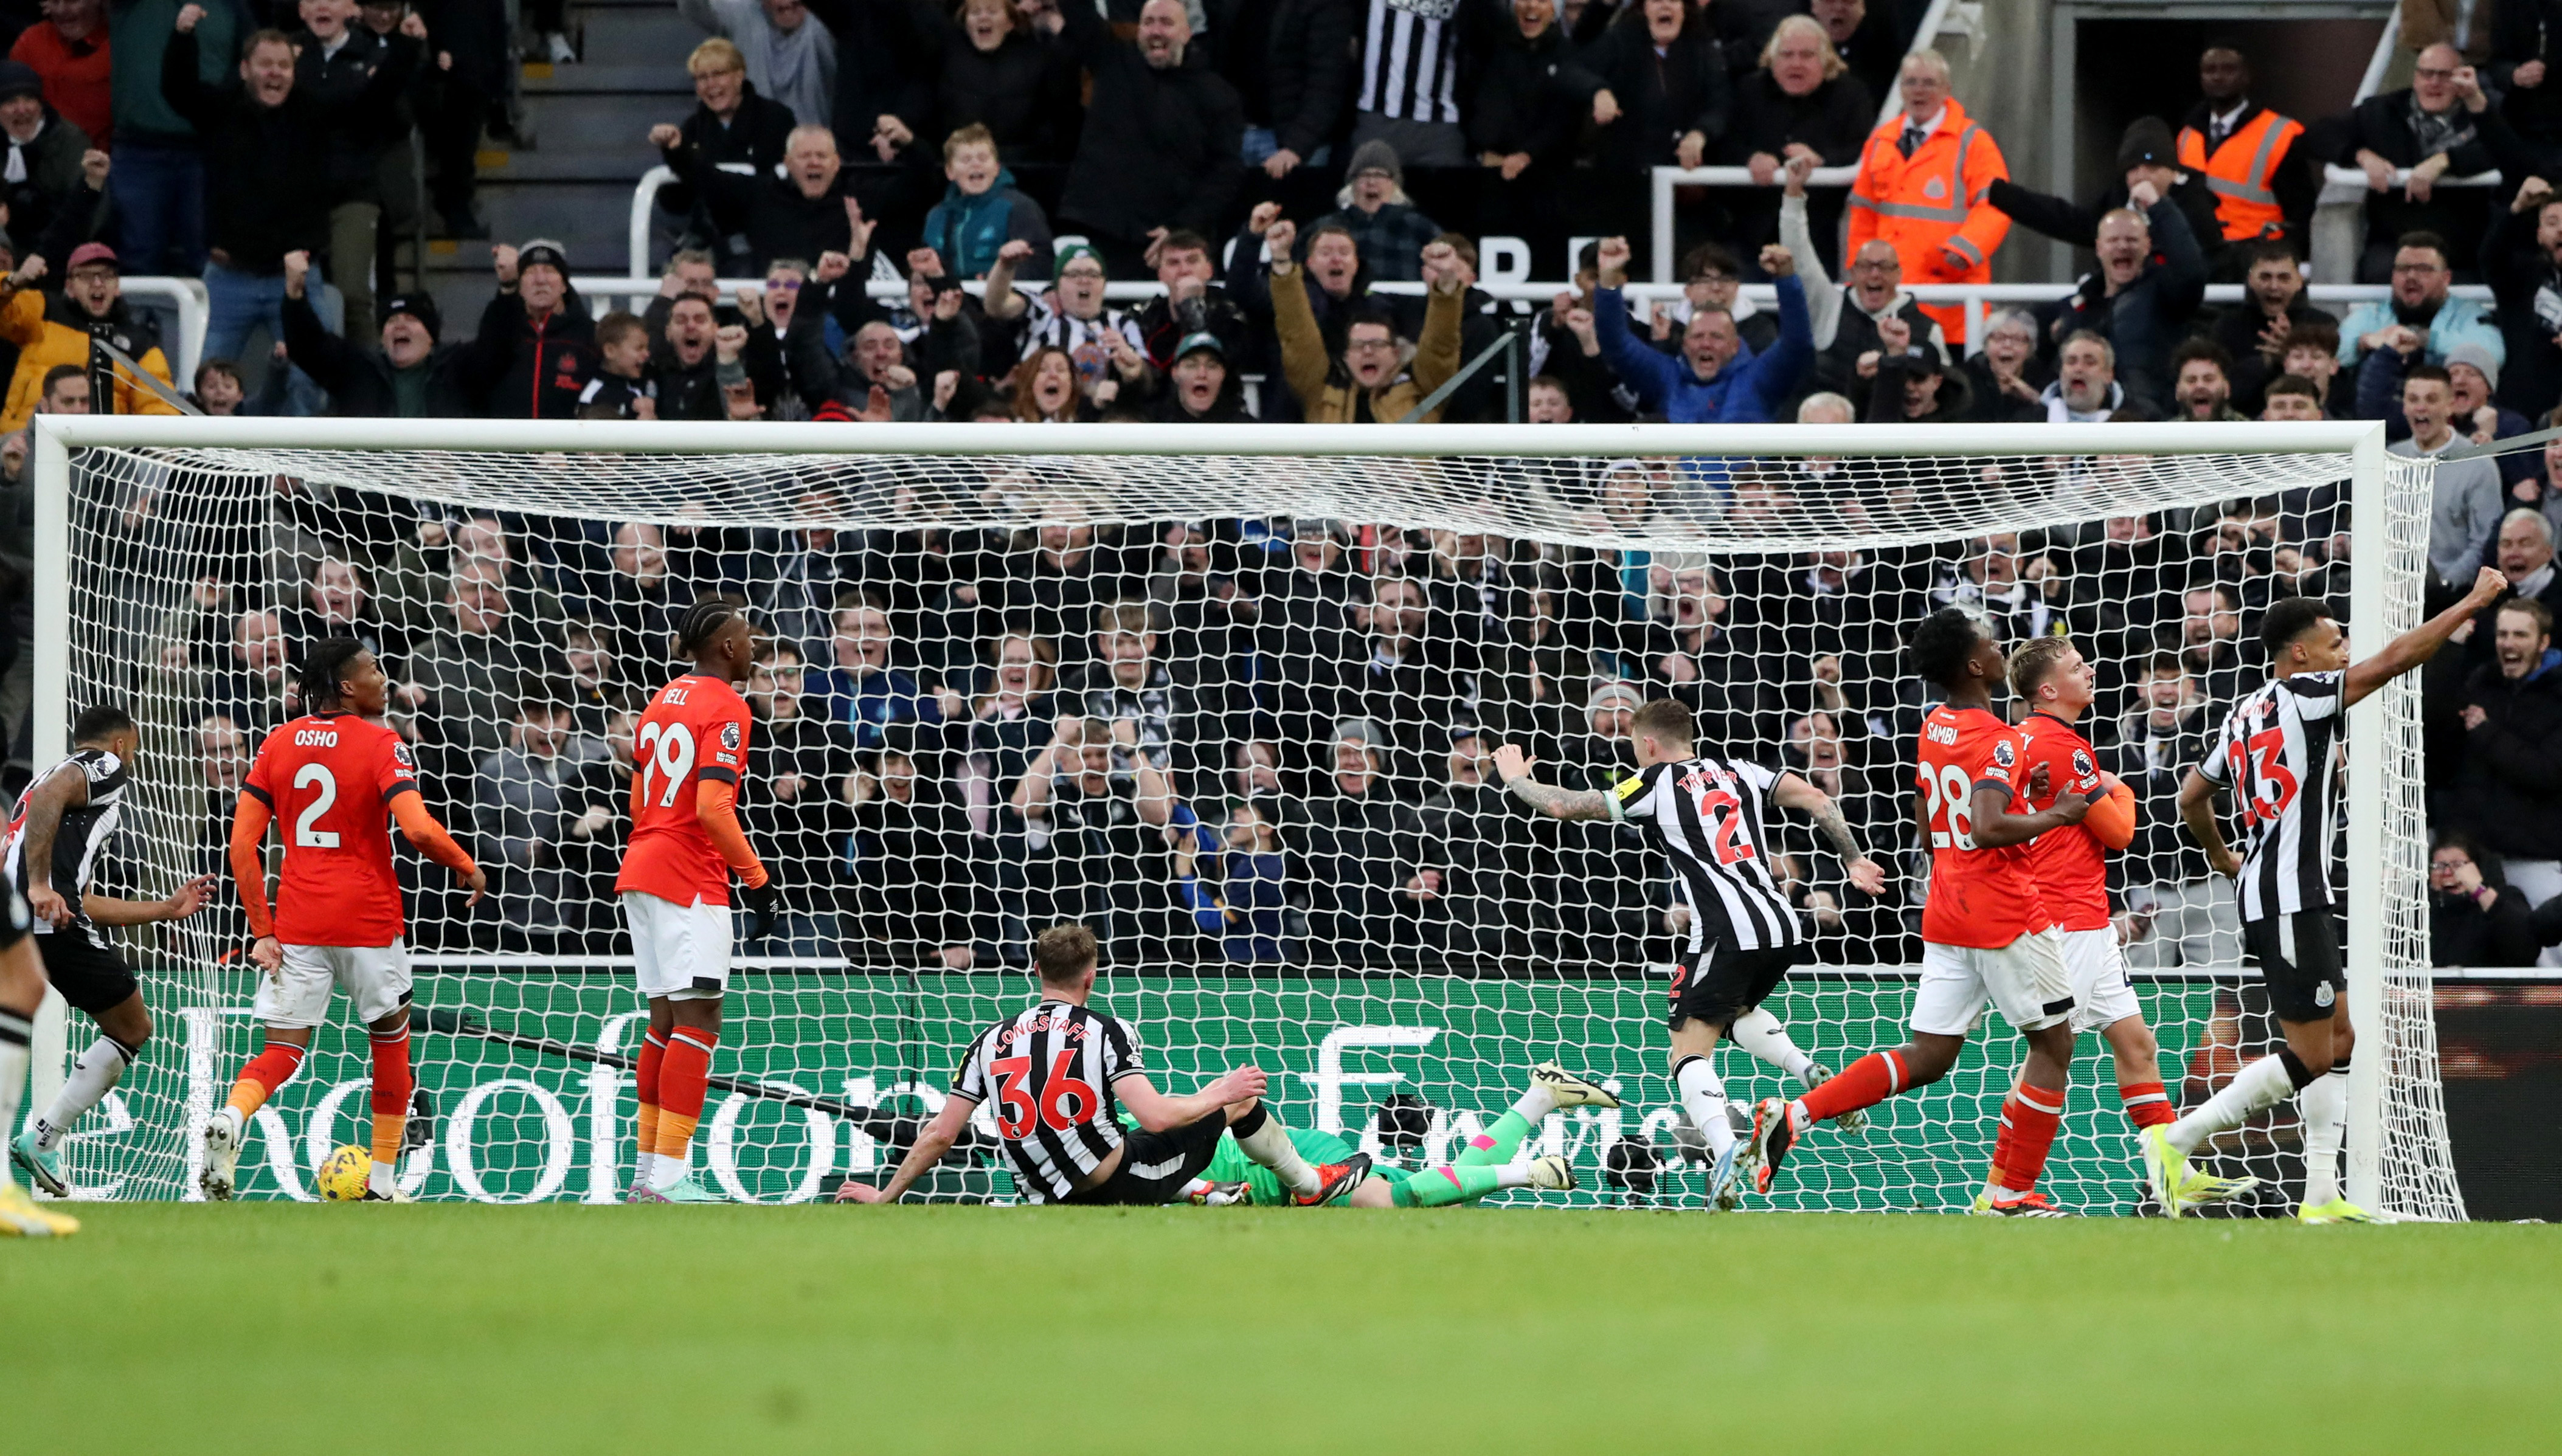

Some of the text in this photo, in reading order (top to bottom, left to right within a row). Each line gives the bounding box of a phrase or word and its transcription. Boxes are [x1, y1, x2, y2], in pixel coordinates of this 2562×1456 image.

[662, 688, 689, 705] BELL
[1927, 722, 1958, 746] SAMBI
[294, 730, 338, 748] OSHO
[640, 721, 696, 807] 29
[2228, 726, 2298, 827] 23
[294, 763, 340, 847] 2
[1701, 788, 1755, 865] 2
[1919, 761, 1978, 850] 28
[1669, 965, 1686, 998] 2
[992, 1015, 1090, 1054] LONGSTAFF
[989, 1048, 1097, 1140] 36
